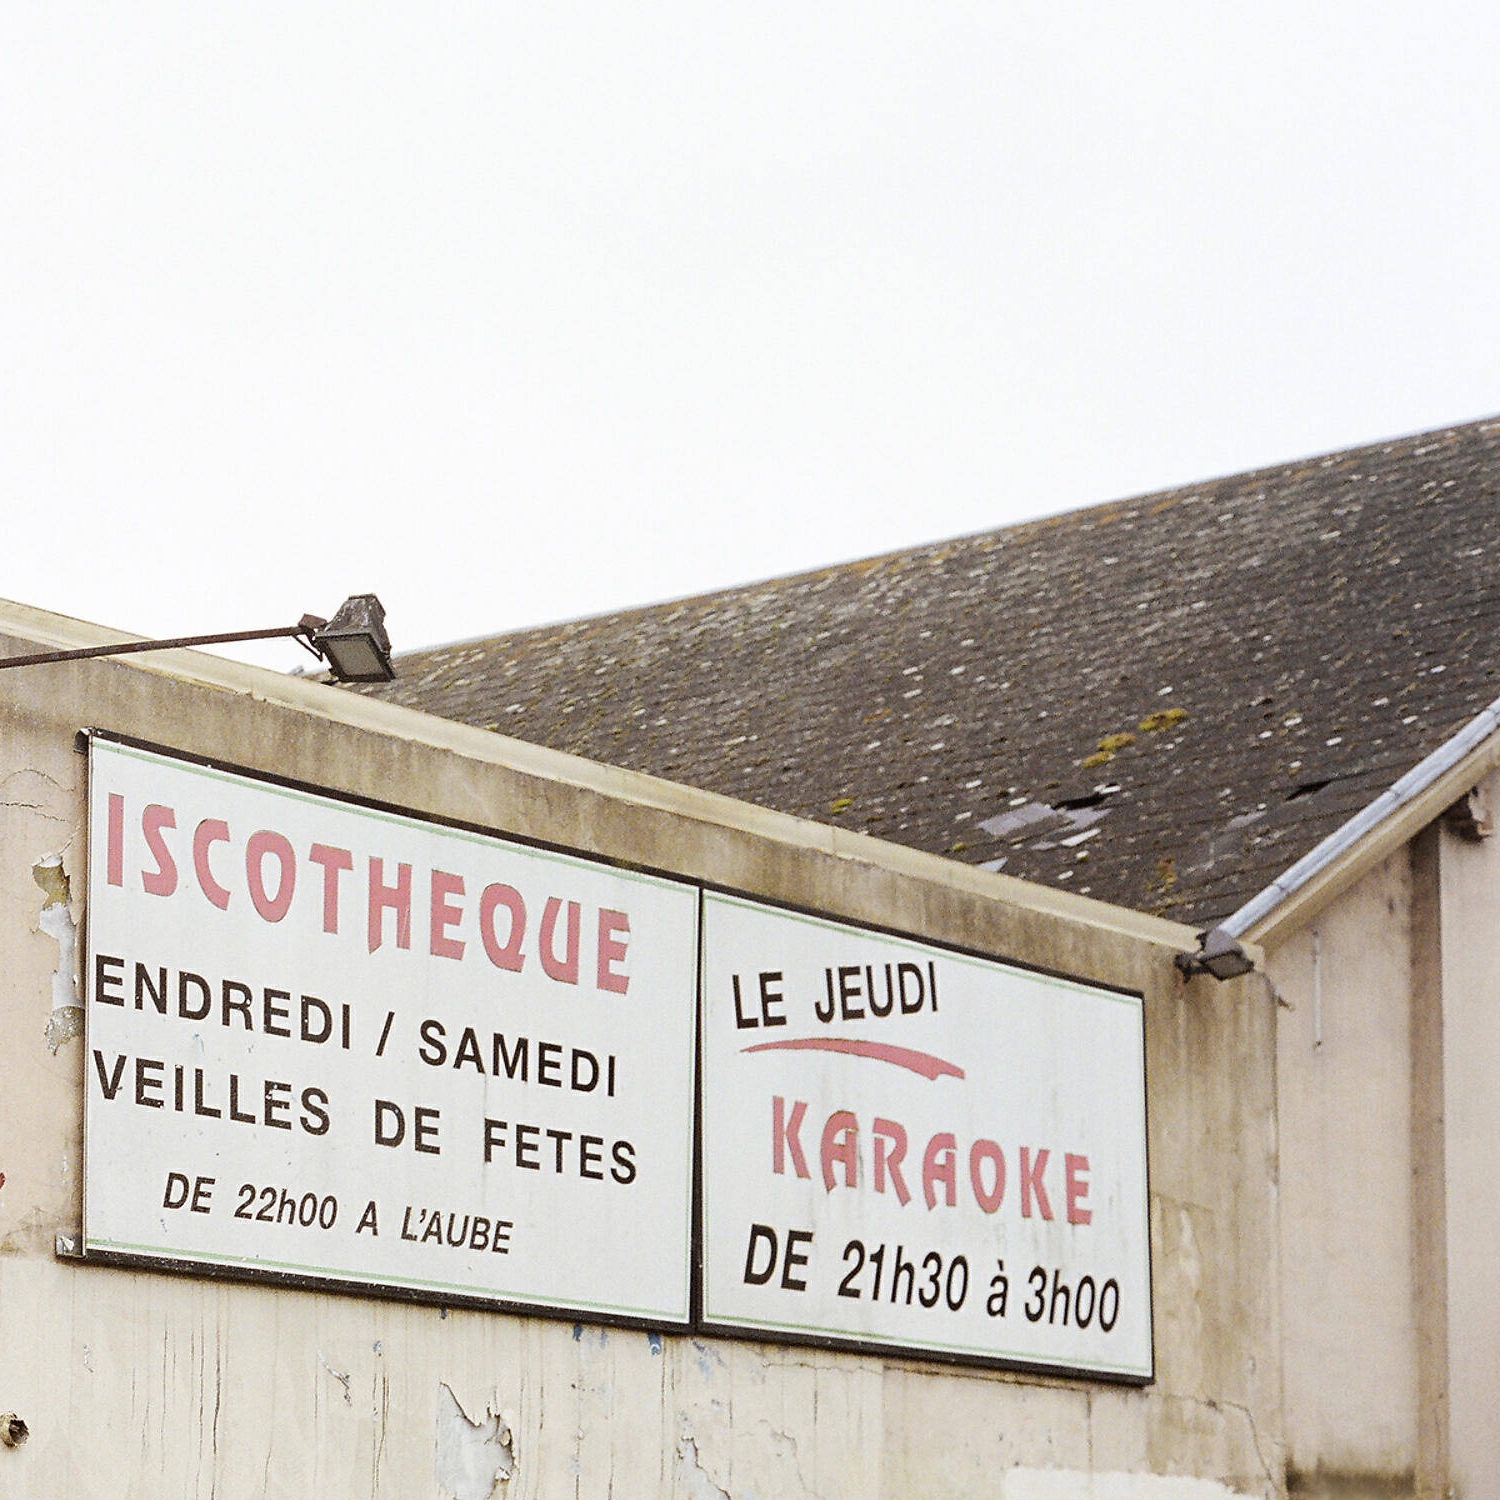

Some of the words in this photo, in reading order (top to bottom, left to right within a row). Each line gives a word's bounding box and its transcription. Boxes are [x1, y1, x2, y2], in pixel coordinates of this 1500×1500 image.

[107, 793, 631, 995] ISCOTHEQUE
[96, 954, 350, 1049] ENDREDI
[418, 1019, 617, 1098] SAMEDI
[732, 971, 787, 1029] LE
[814, 961, 938, 1024] JEUDI
[92, 1049, 330, 1136] VEILLES
[375, 1099, 441, 1155] DE
[485, 1118, 638, 1185] FETES
[772, 1095, 1094, 1226] KARAOKE
[163, 1172, 216, 1214] DE
[235, 1183, 339, 1230] 22h00
[356, 1200, 380, 1236] A
[401, 1205, 514, 1255] L'AUBE
[743, 1223, 815, 1292] DE
[837, 1239, 969, 1312] 21h30
[986, 1259, 1010, 1318] à
[1024, 1265, 1120, 1333] 3h00
